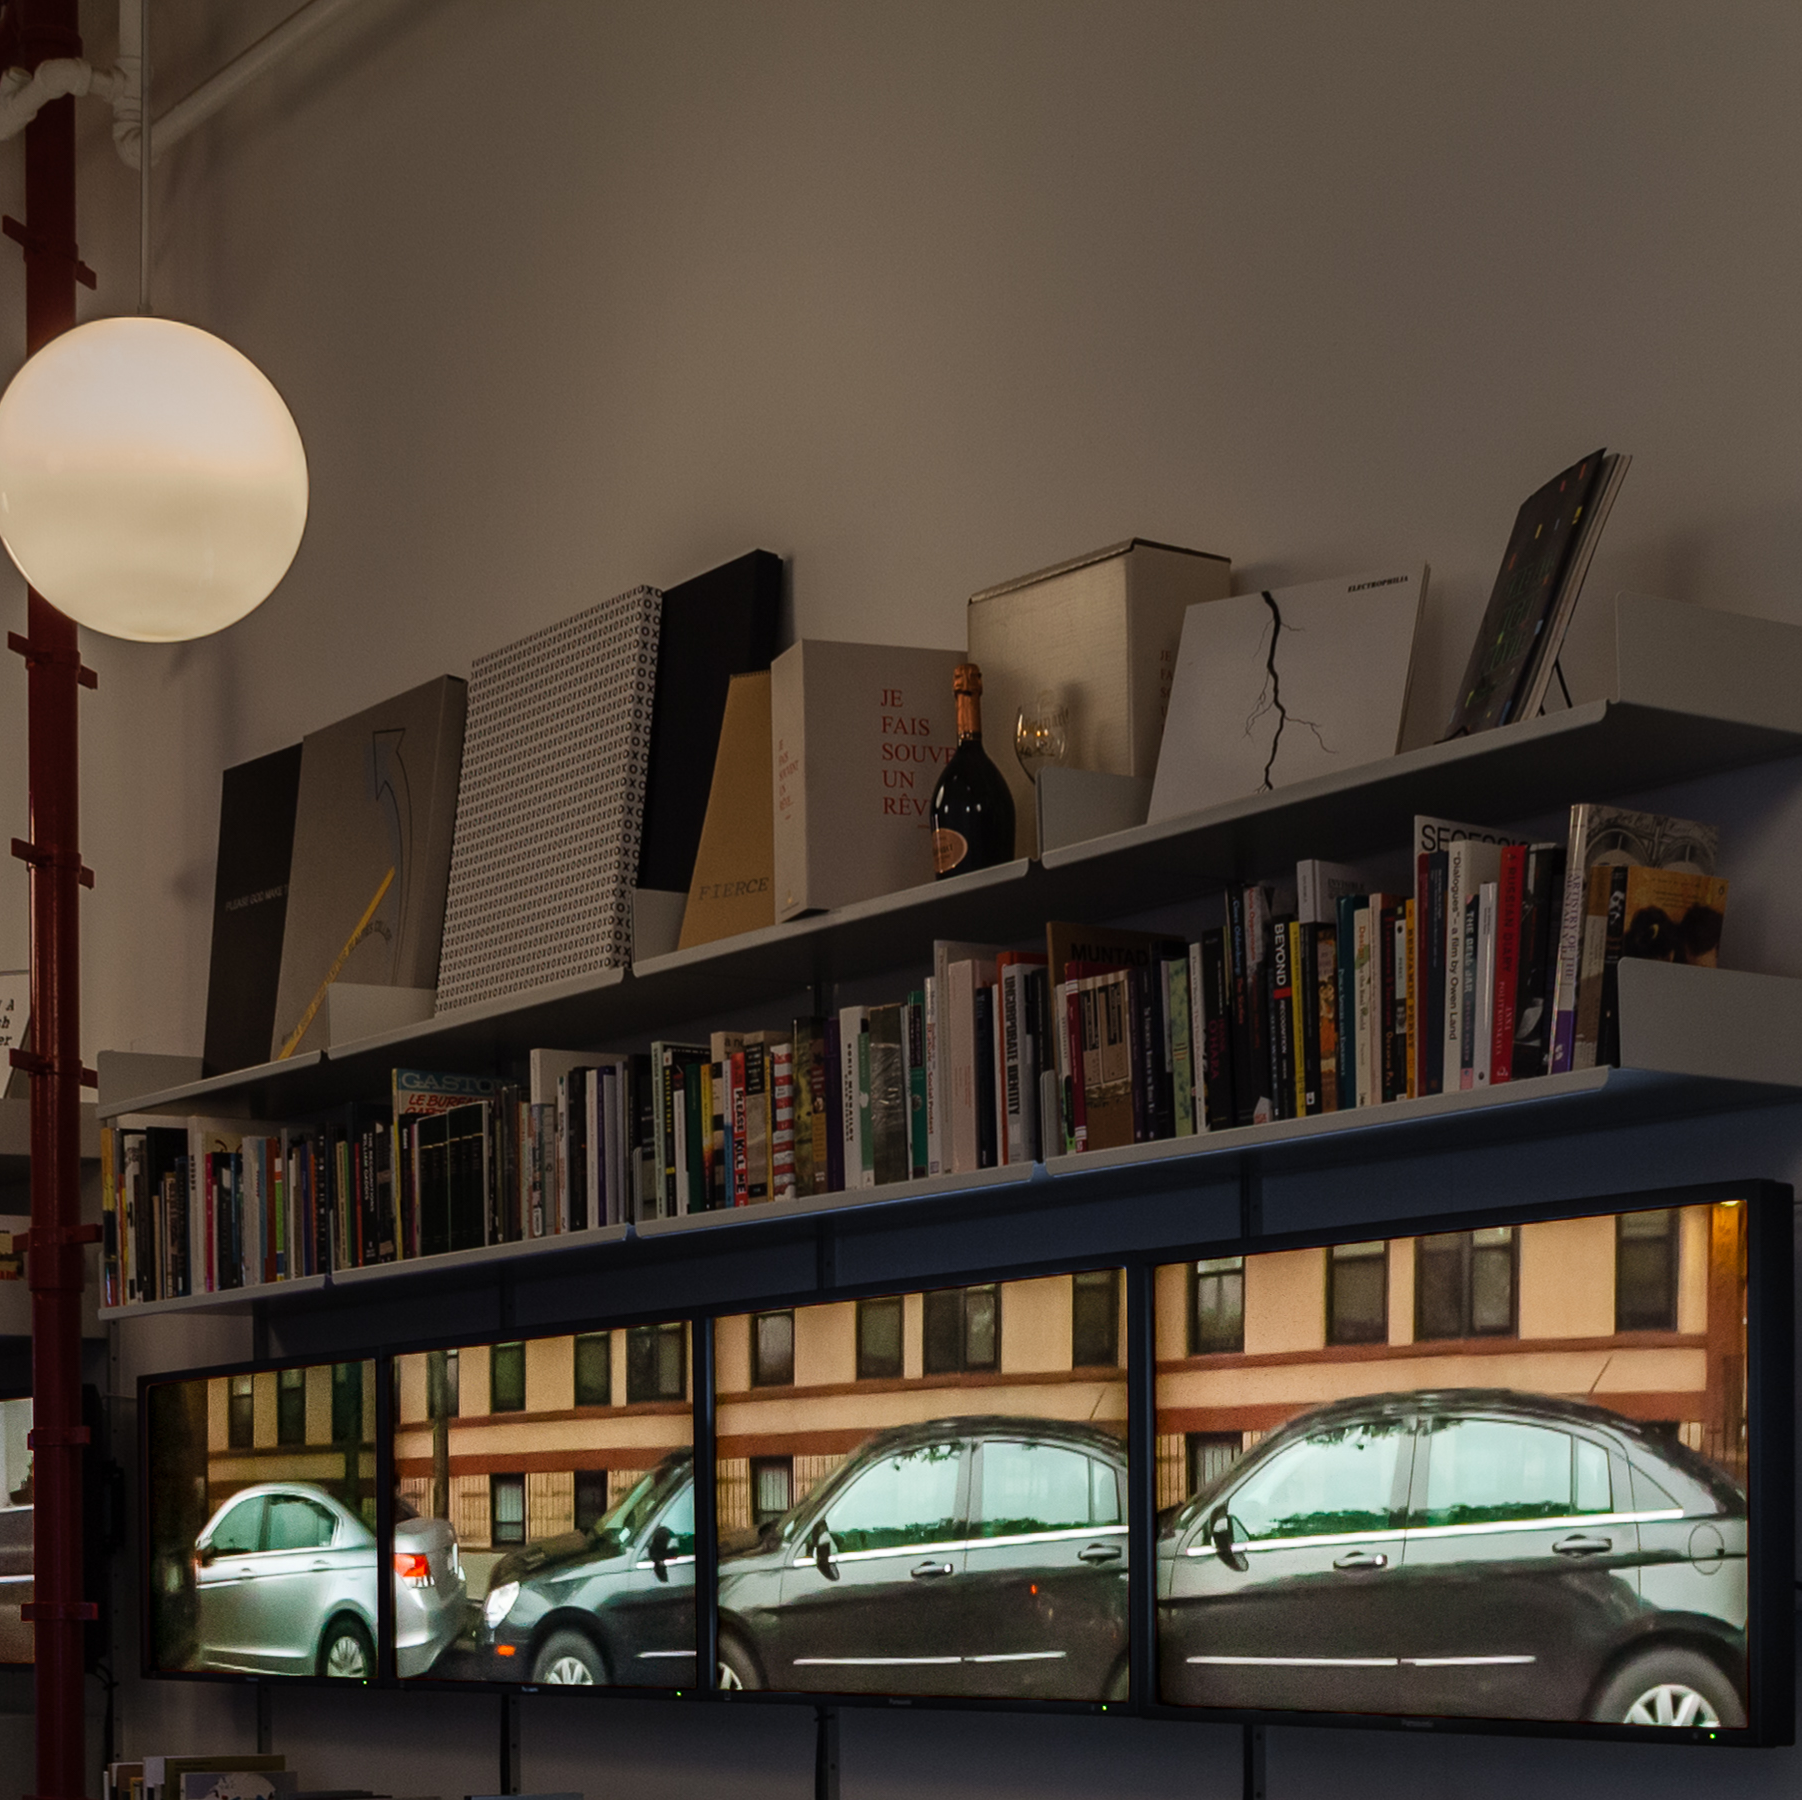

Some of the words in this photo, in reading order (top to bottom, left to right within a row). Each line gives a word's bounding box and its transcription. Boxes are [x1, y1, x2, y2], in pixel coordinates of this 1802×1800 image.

[880, 689, 904, 708] JE
[881, 716, 931, 736] FAIS
[882, 770, 915, 790] UN
[700, 876, 770, 901] FIERCE
[1274, 922, 1286, 987] BEYOND
[1451, 938, 1461, 957] film
[1449, 959, 1459, 976] by
[1450, 977, 1459, 1005] Owen
[6, 999, 15, 1012] A
[1449, 1007, 1457, 1041] Land
[734, 1087, 746, 1132] PLEASE
[735, 1138, 745, 1170] KILL
